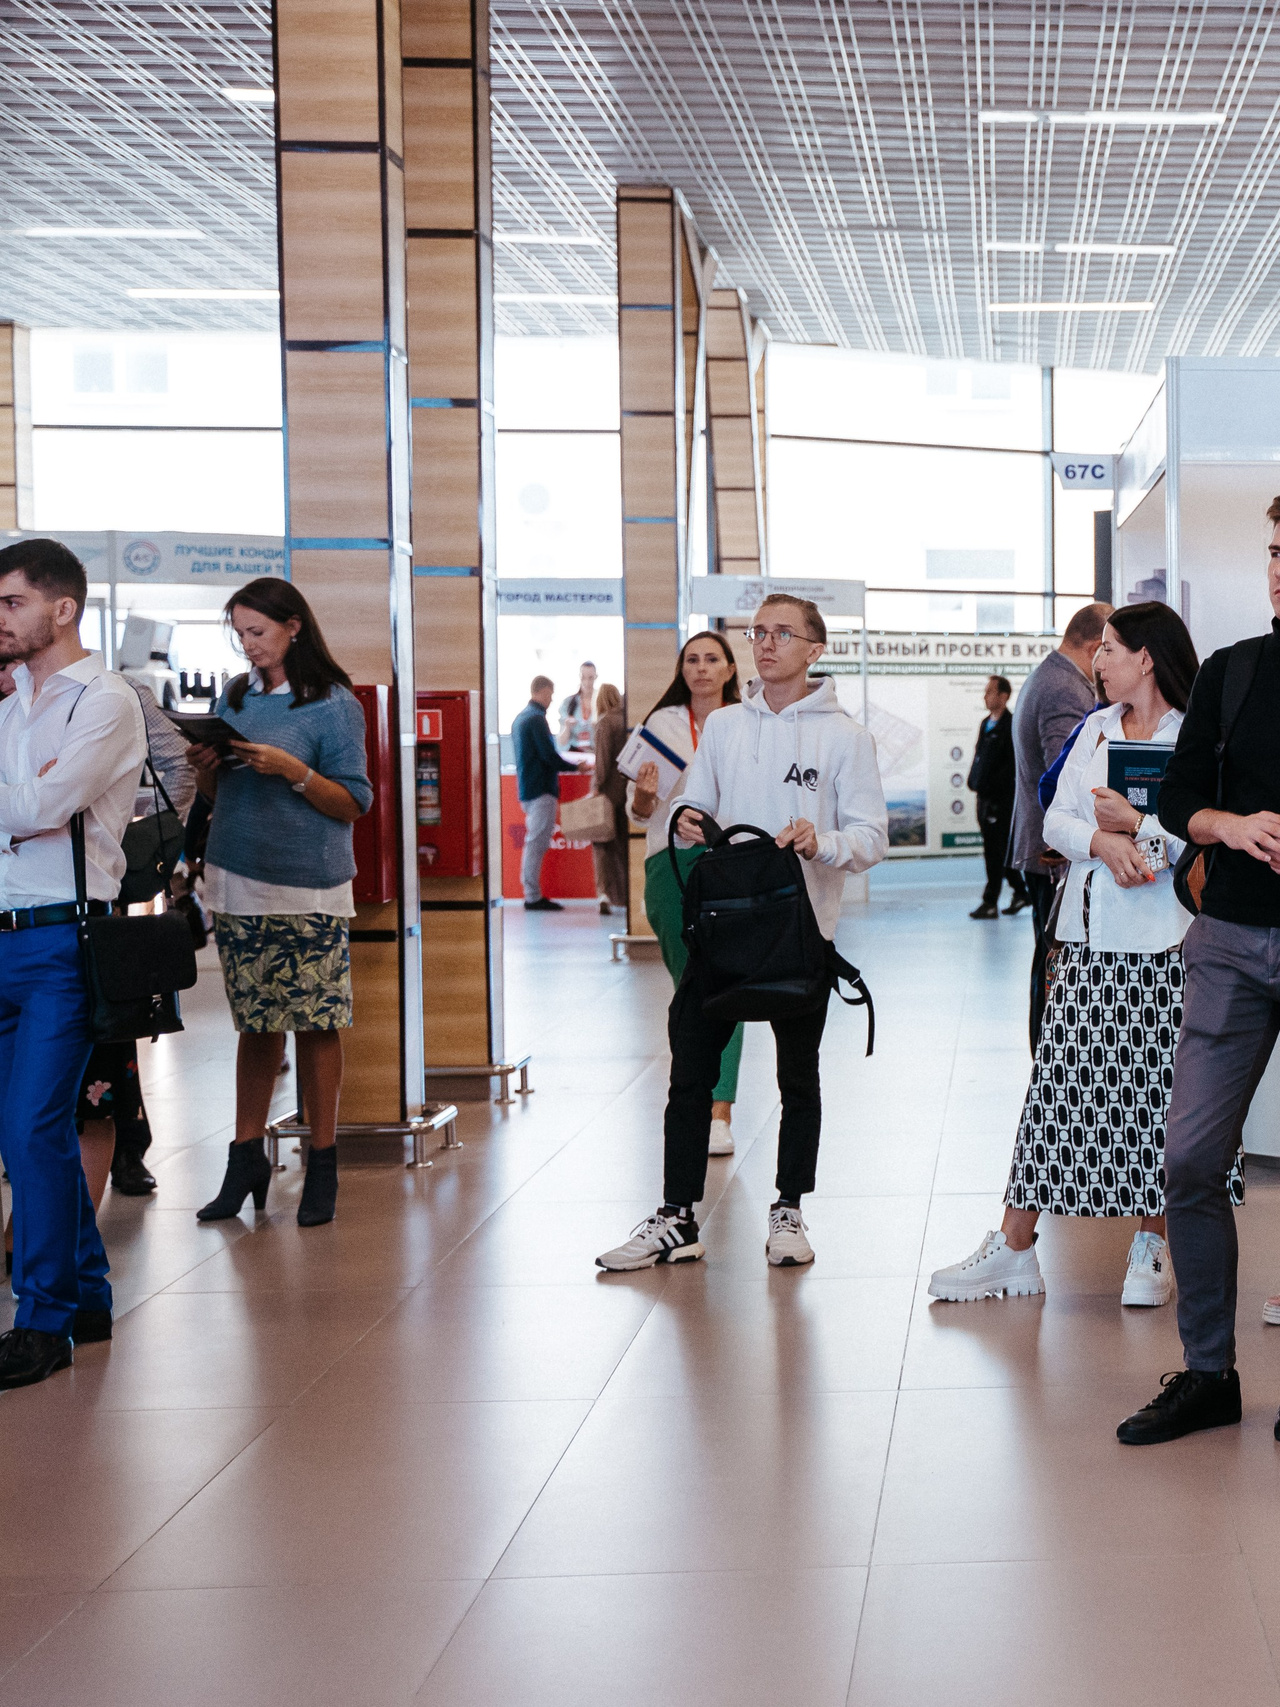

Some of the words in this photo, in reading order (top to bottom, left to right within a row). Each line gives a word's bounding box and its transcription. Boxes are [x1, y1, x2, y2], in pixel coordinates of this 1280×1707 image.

[175, 543, 234, 558] ЛУЧШИЕ
[191, 561, 221, 574] ДЛЯ
[936, 644, 1006, 657] ПРОЕКТ
[1012, 644, 1021, 657] В
